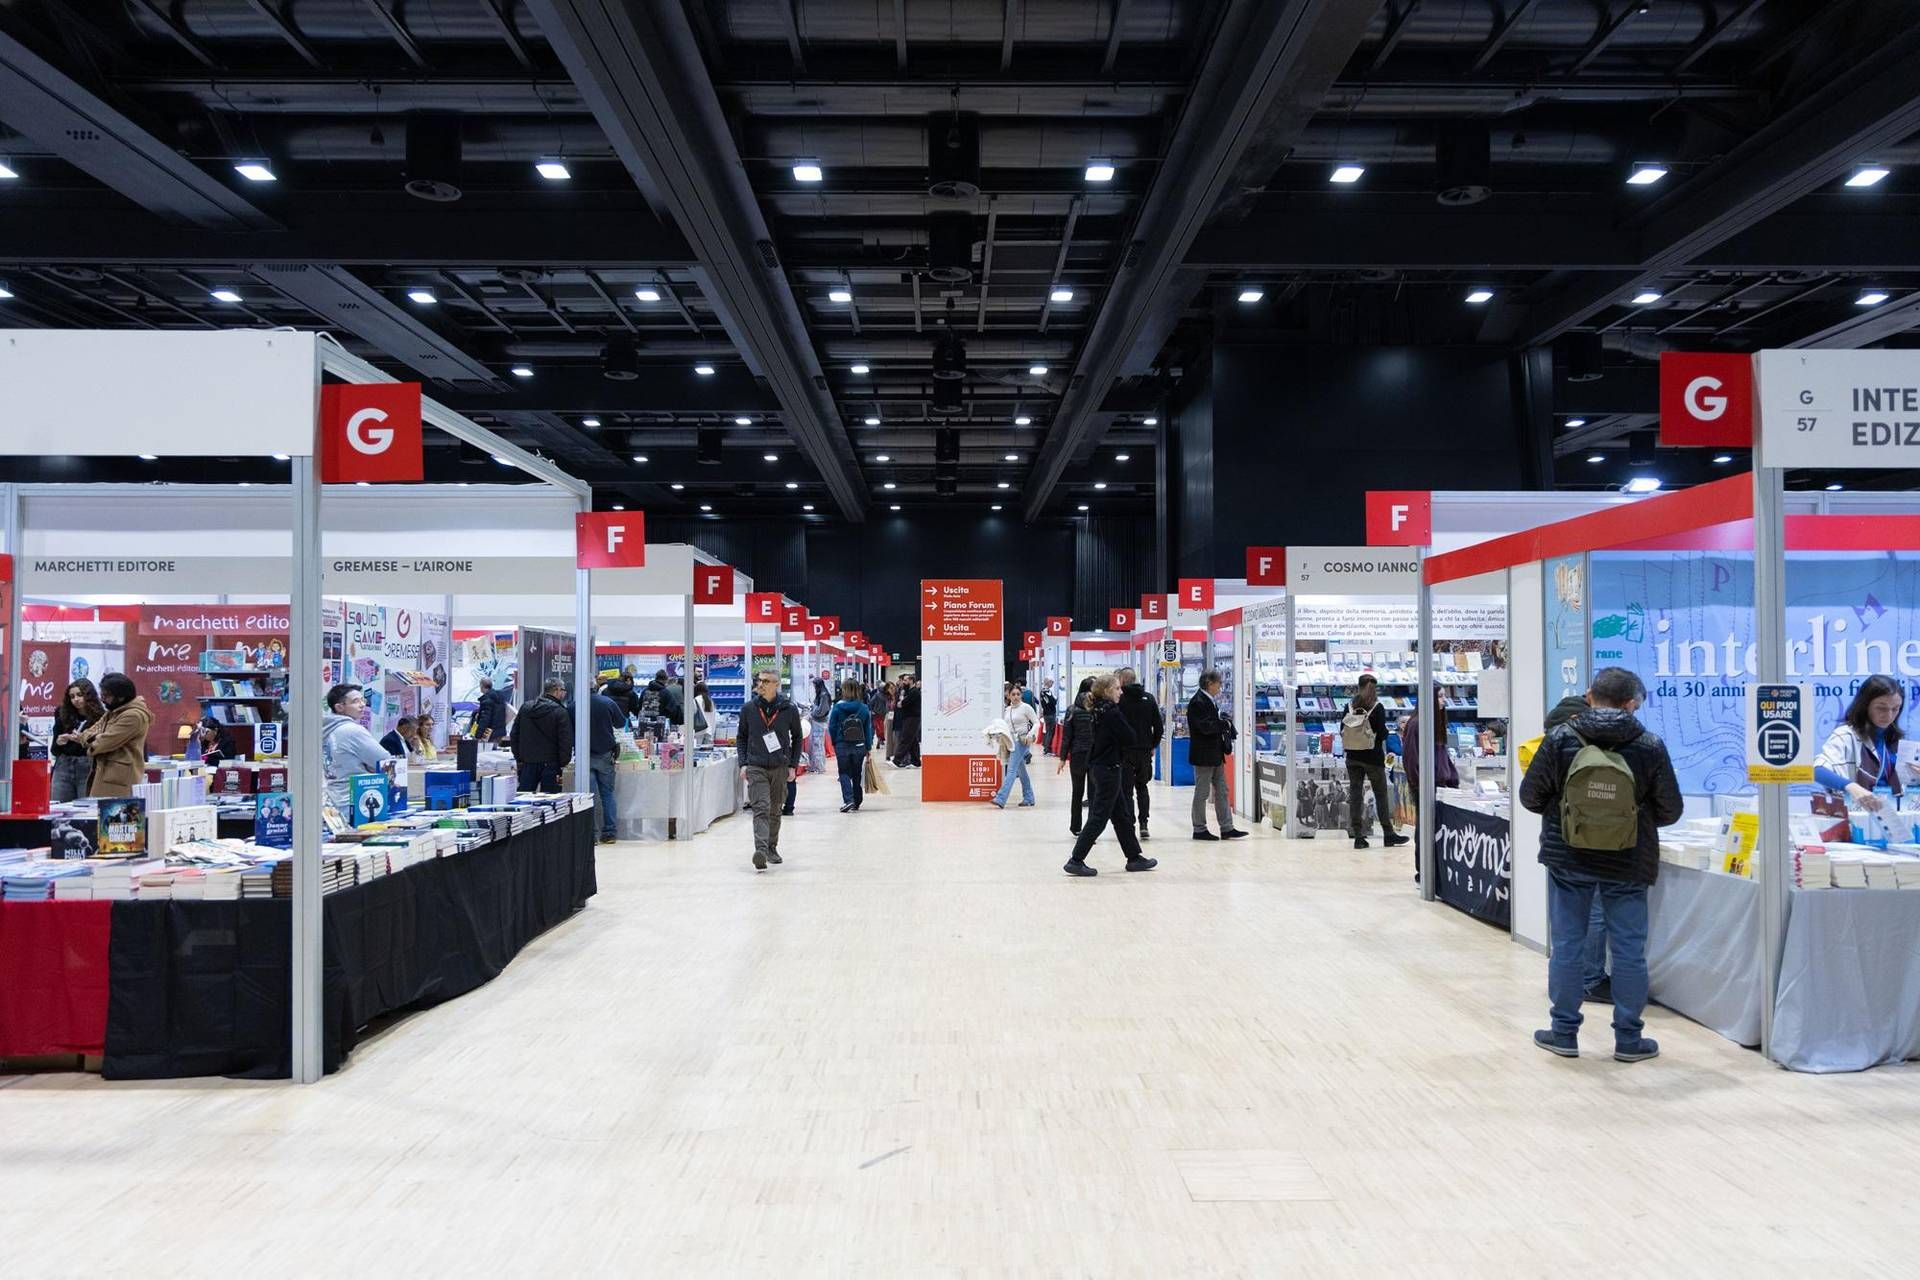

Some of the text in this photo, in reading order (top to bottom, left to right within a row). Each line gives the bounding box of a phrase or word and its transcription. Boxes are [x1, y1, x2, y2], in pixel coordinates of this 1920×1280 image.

[1684, 376, 1728, 421] G
[1800, 390, 1814, 404] G
[1853, 388, 1918, 411] INTE
[347, 408, 394, 455] G
[1797, 418, 1817, 431] 57
[1852, 422, 1920, 446] EDIZ
[1391, 505, 1408, 531] F
[607, 526, 625, 553] F
[34, 561, 175, 572] MARCHETTI EDITORE
[333, 561, 398, 572] GREMESE
[1259, 557, 1272, 576] F
[1324, 562, 1374, 573] COSMO
[708, 576, 720, 595] F
[943, 586, 970, 594] Uscita
[1191, 586, 1201, 601] E
[762, 600, 772, 616] E
[943, 601, 995, 609] Piano Forum
[1149, 601, 1157, 613] E
[154, 614, 239, 630] marchetti
[347, 611, 379, 627] SQUID
[789, 612, 799, 626] E
[1116, 614, 1126, 625] D
[814, 624, 823, 635] D
[1053, 622, 1062, 632] D
[850, 635, 857, 643] C
[1028, 635, 1035, 644] C
[1657, 680, 1678, 697] da
[1683, 681, 1705, 698] 30
[1711, 680, 1745, 697] anni
[1760, 701, 1797, 710] QUI PUOI
[1763, 710, 1793, 718] USARE
